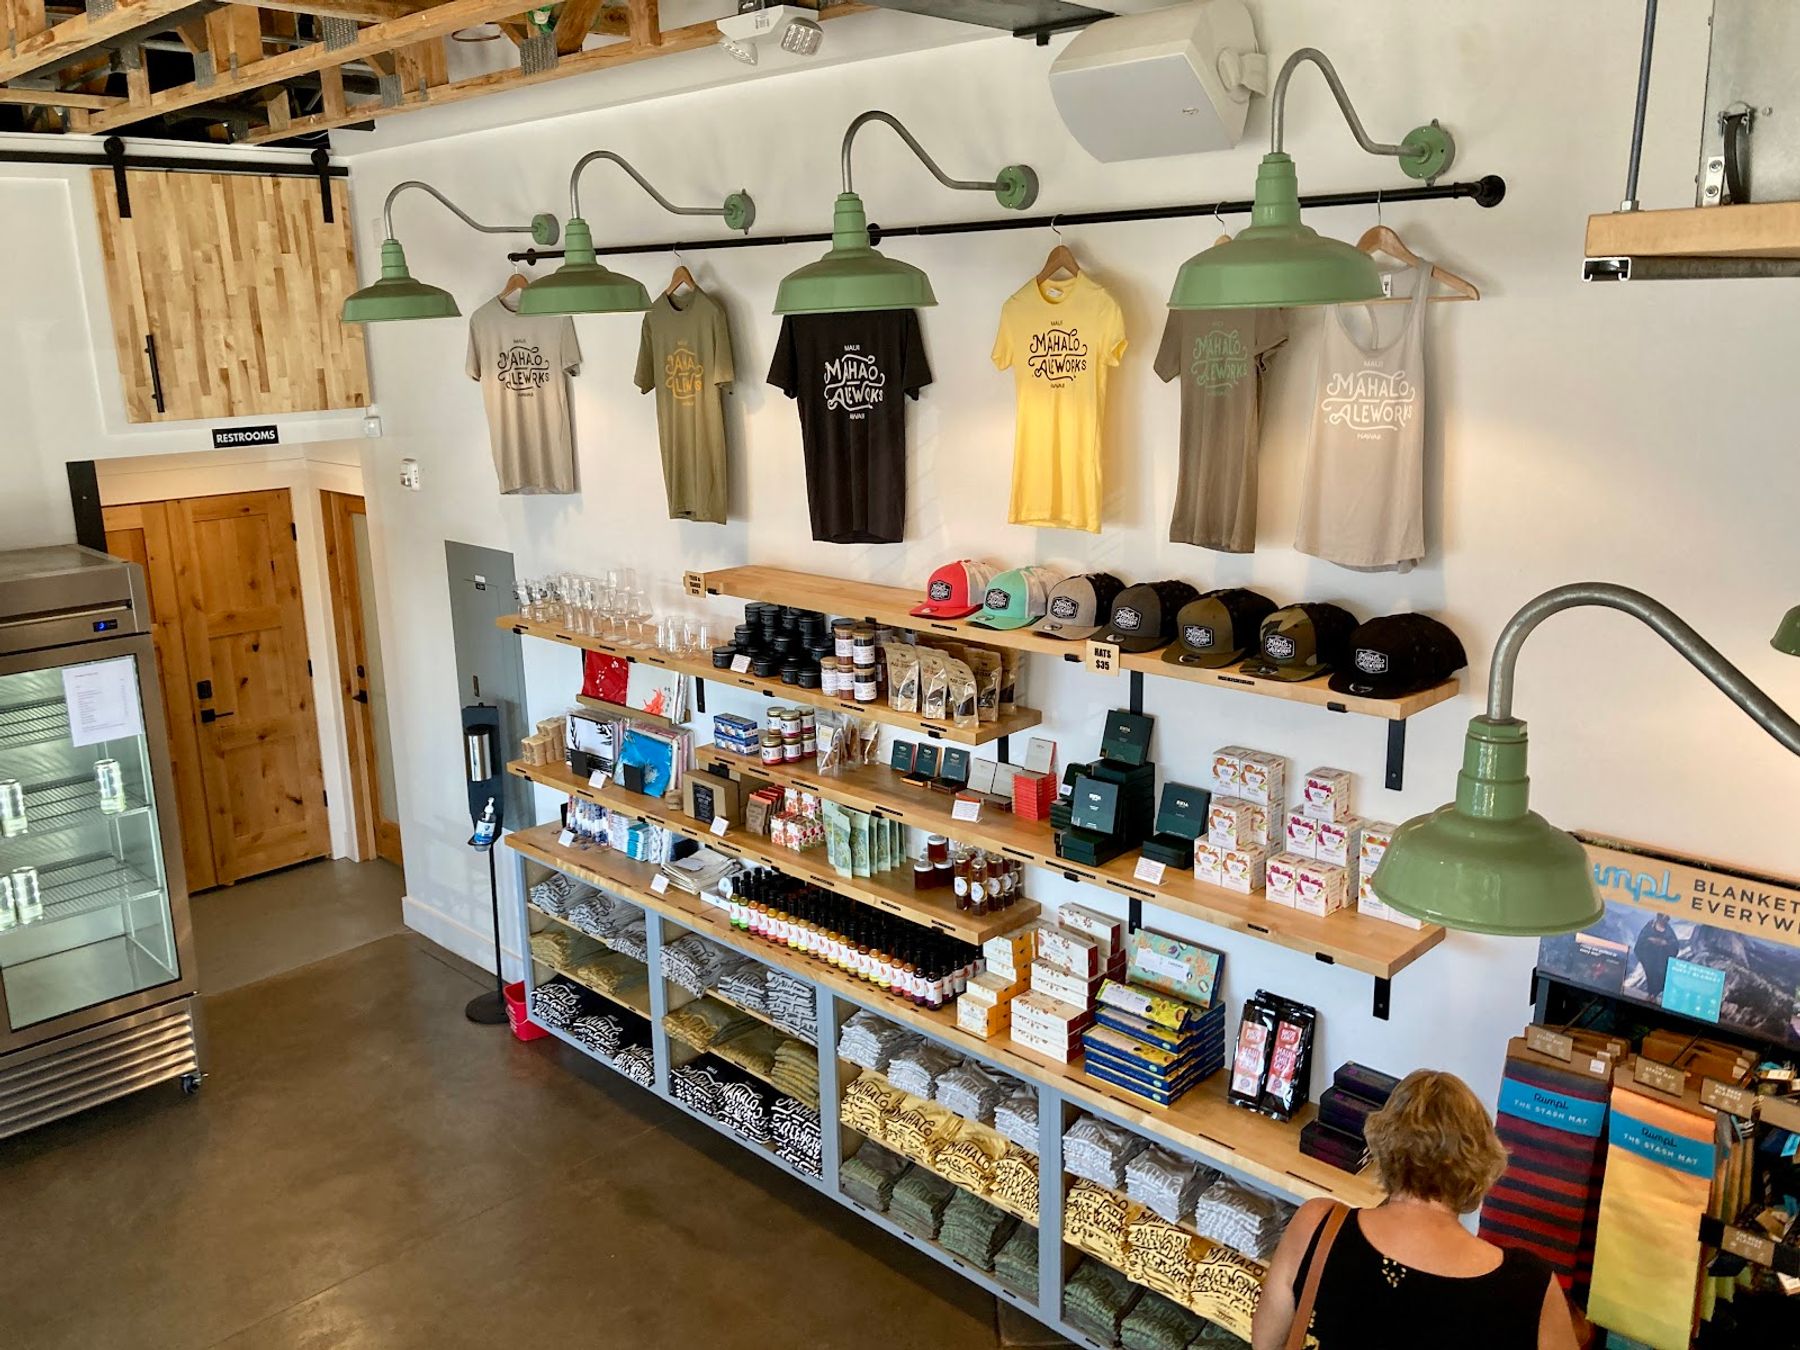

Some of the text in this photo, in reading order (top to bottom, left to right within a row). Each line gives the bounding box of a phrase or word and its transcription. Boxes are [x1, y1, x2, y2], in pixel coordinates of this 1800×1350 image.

[1030, 329, 1080, 354] MAHALO
[824, 354, 879, 384] MAHAO
[1327, 370, 1409, 397] MAHALO
[216, 430, 276, 444] RESTROOMS
[1094, 647, 1112, 659] HATS
[1095, 660, 1110, 671] $35
[1593, 861, 1682, 903] umpl
[846, 1079, 892, 1109] MAHALO
[1514, 1099, 1589, 1125] THE STASH MAT
[946, 1140, 993, 1171] MAHALO
[1623, 1133, 1698, 1165] THE STASH MAT
